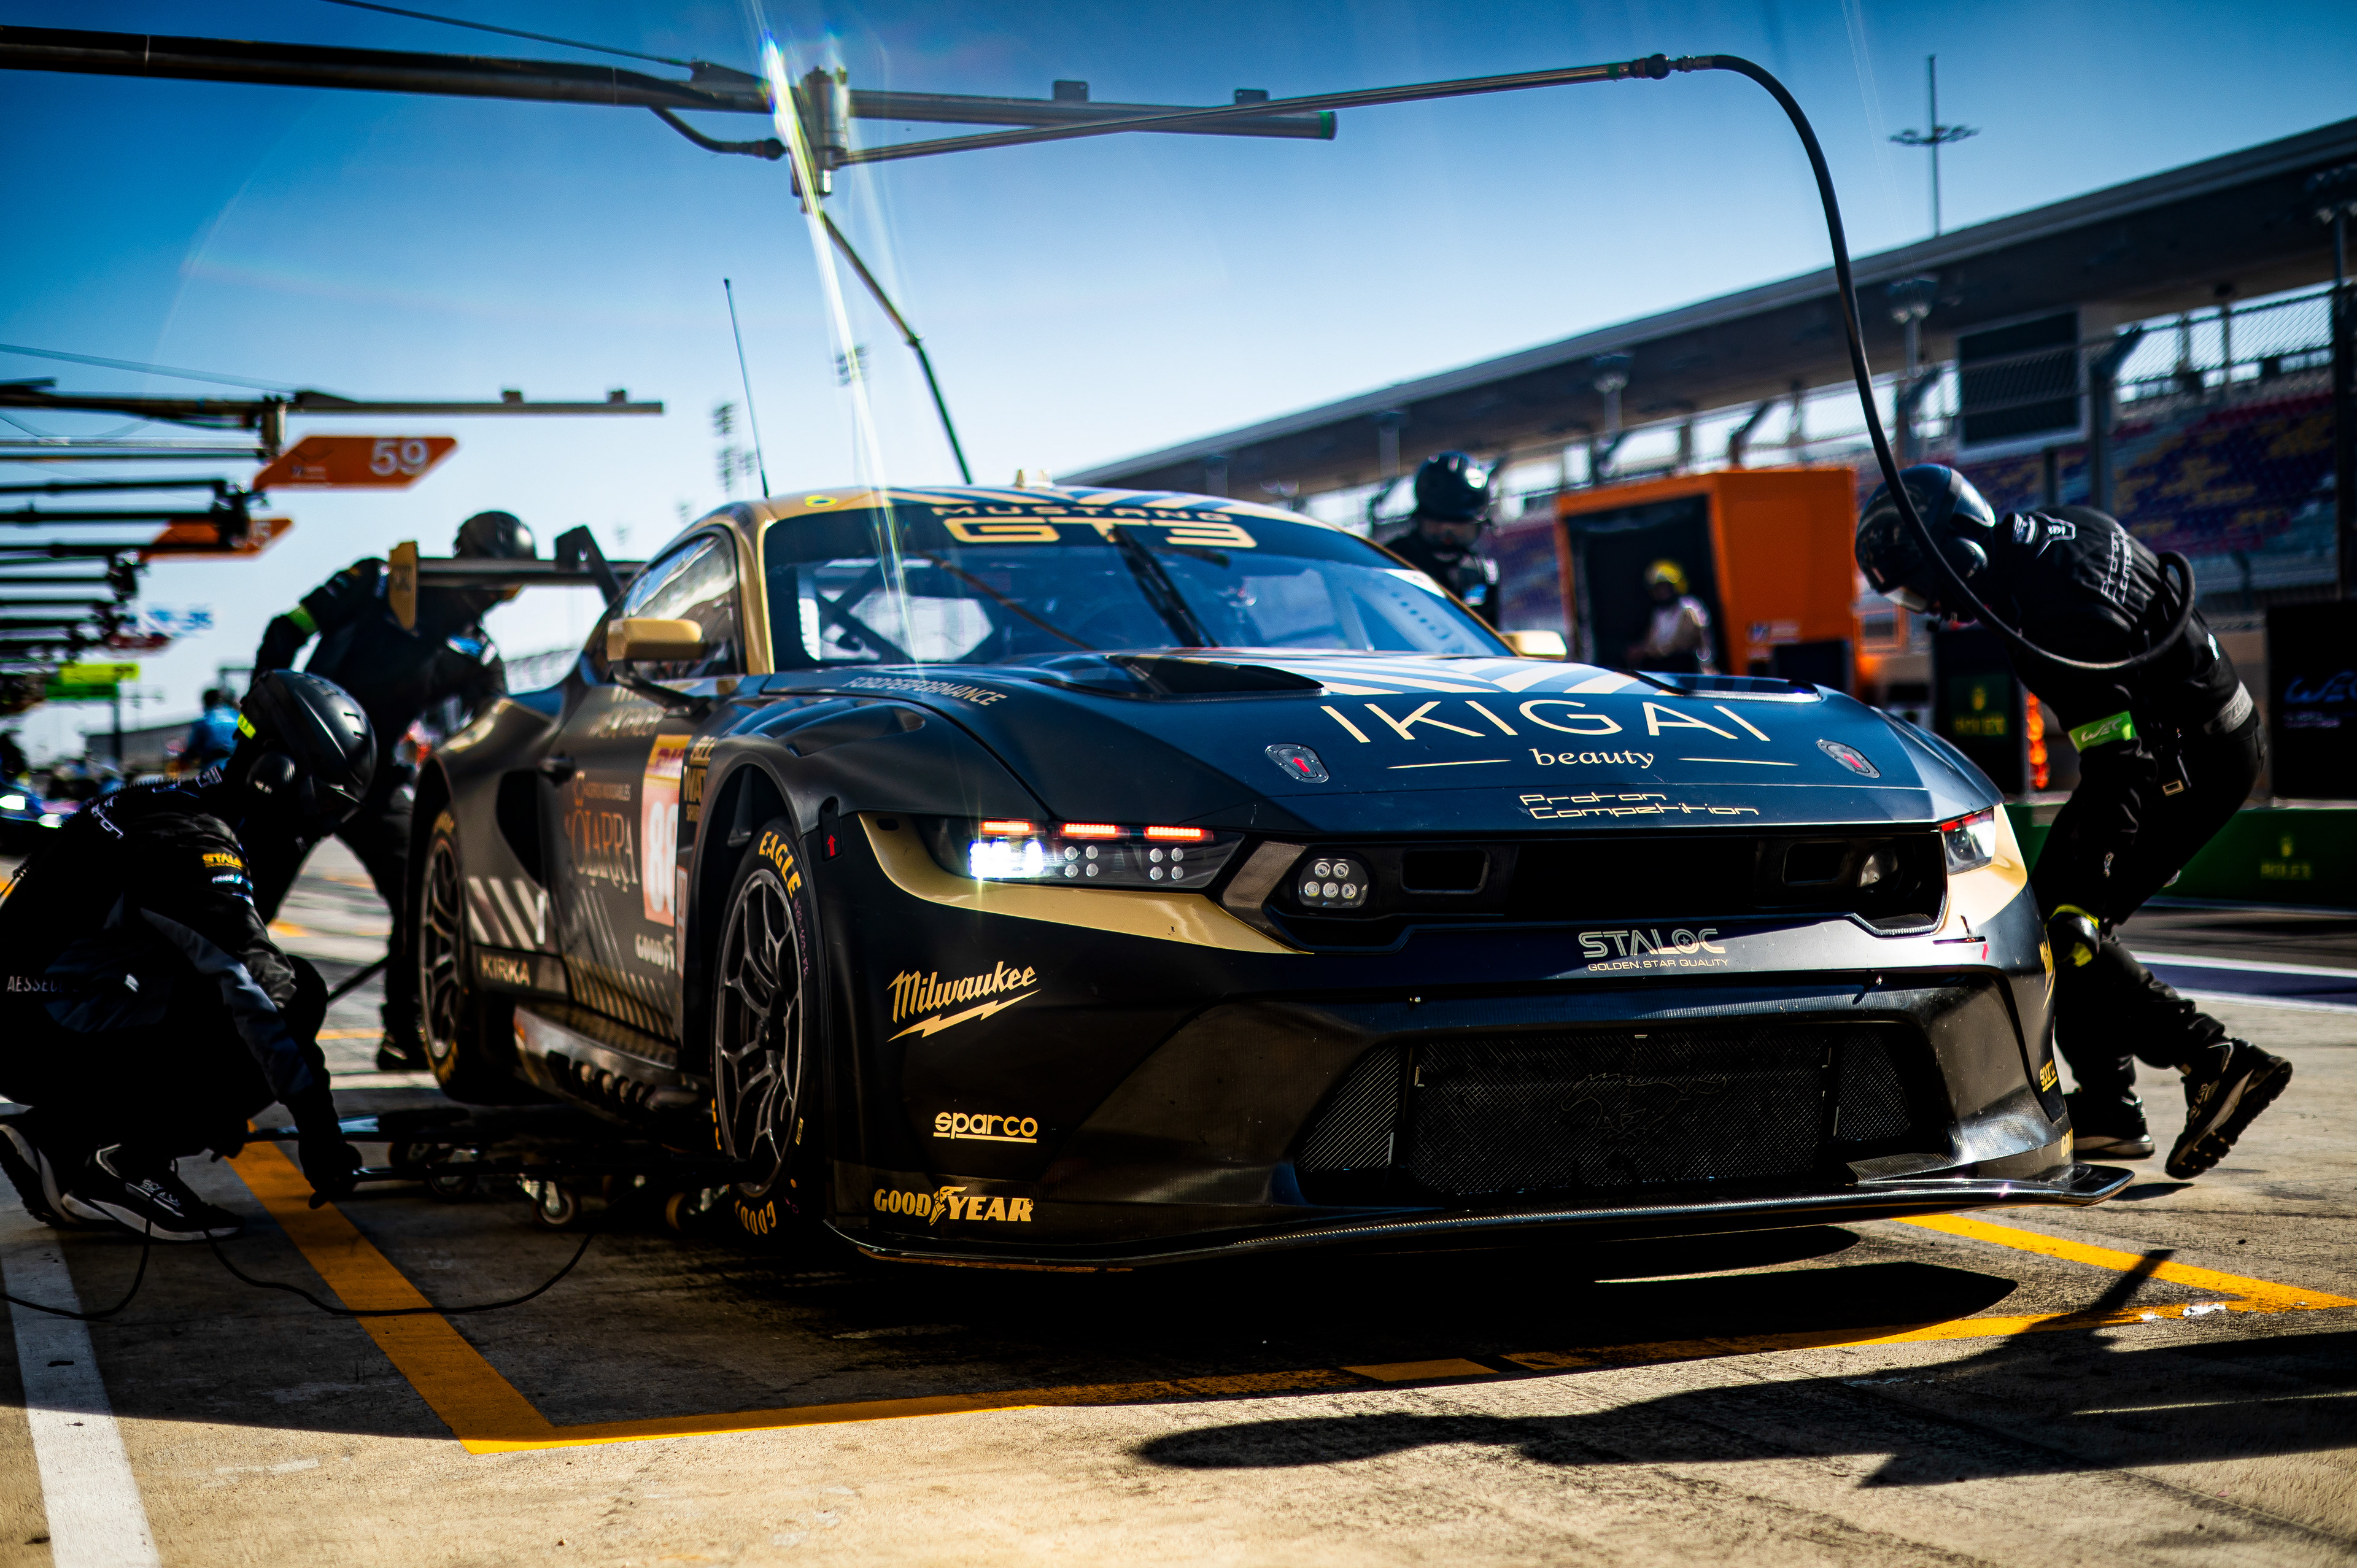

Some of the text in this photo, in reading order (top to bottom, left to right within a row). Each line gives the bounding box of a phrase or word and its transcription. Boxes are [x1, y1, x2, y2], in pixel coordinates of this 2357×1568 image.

[370, 438, 428, 477] 59
[931, 505, 1233, 522] MUSTANG
[943, 517, 1258, 548] GT3
[1320, 699, 1771, 743] IKIGAI
[1528, 747, 1654, 768] beauty
[1520, 792, 1667, 805] Proton
[1529, 803, 1759, 819] Competition
[759, 831, 802, 899] EAGLE
[1578, 929, 1726, 958] STALOC
[479, 954, 531, 986] KIRKA
[1588, 958, 1729, 971] GOLDEN STAR QUALITY
[886, 961, 1038, 1024] Milwaukee
[934, 1111, 1038, 1140] sparco
